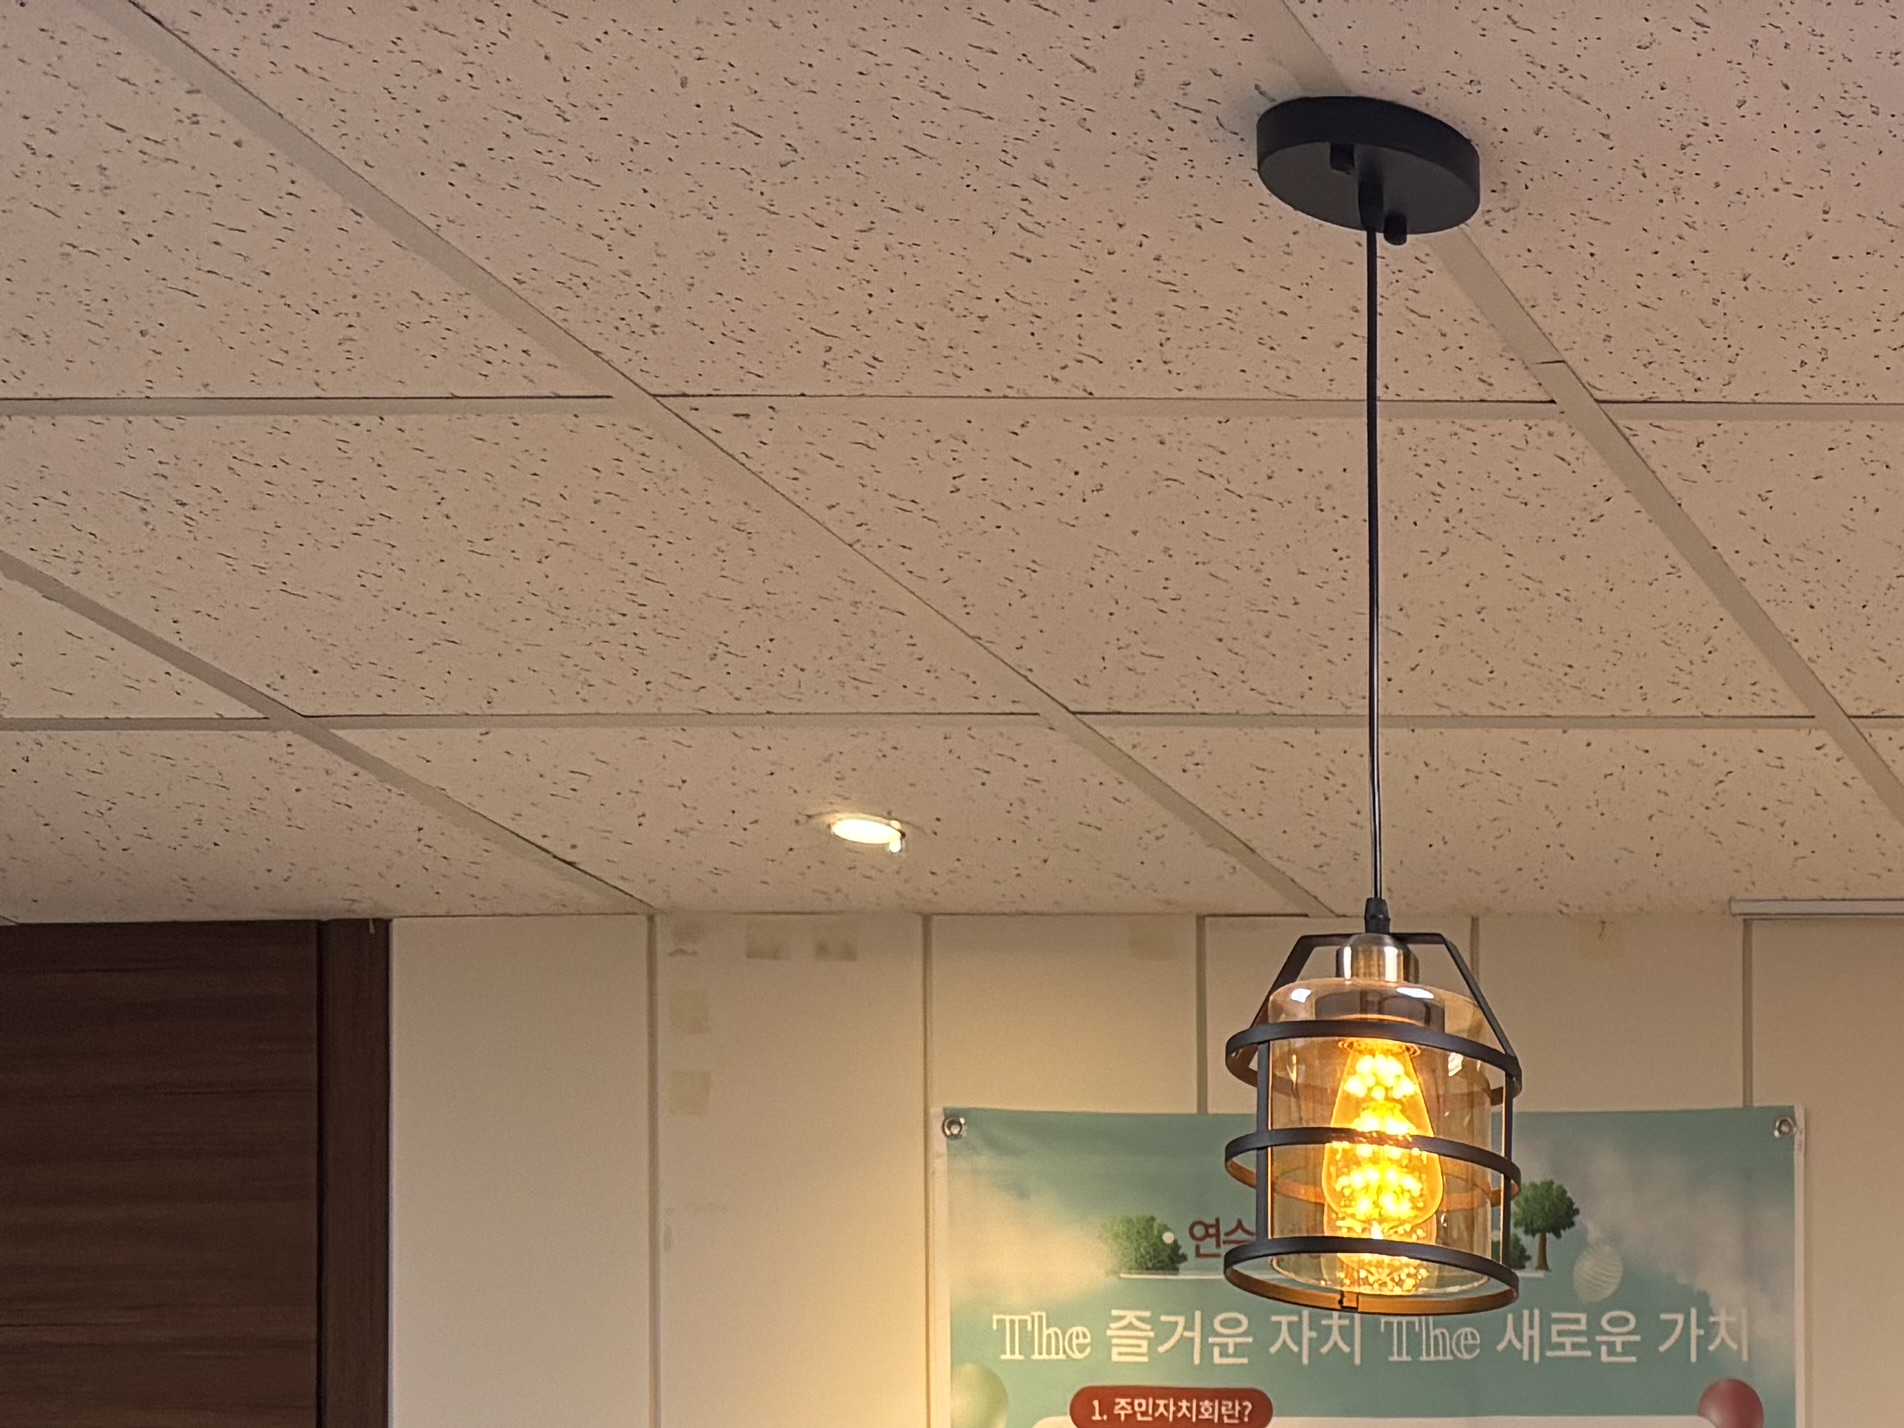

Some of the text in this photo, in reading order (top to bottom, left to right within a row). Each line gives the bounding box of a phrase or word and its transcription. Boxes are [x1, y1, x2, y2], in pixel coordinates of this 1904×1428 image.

[1188, 1216, 1257, 1258] 연수
[992, 1305, 1750, 1366] The 즐거운 자치 The 새로운 가치
[1090, 1397, 1253, 1424] 1. 주민자치회란?
